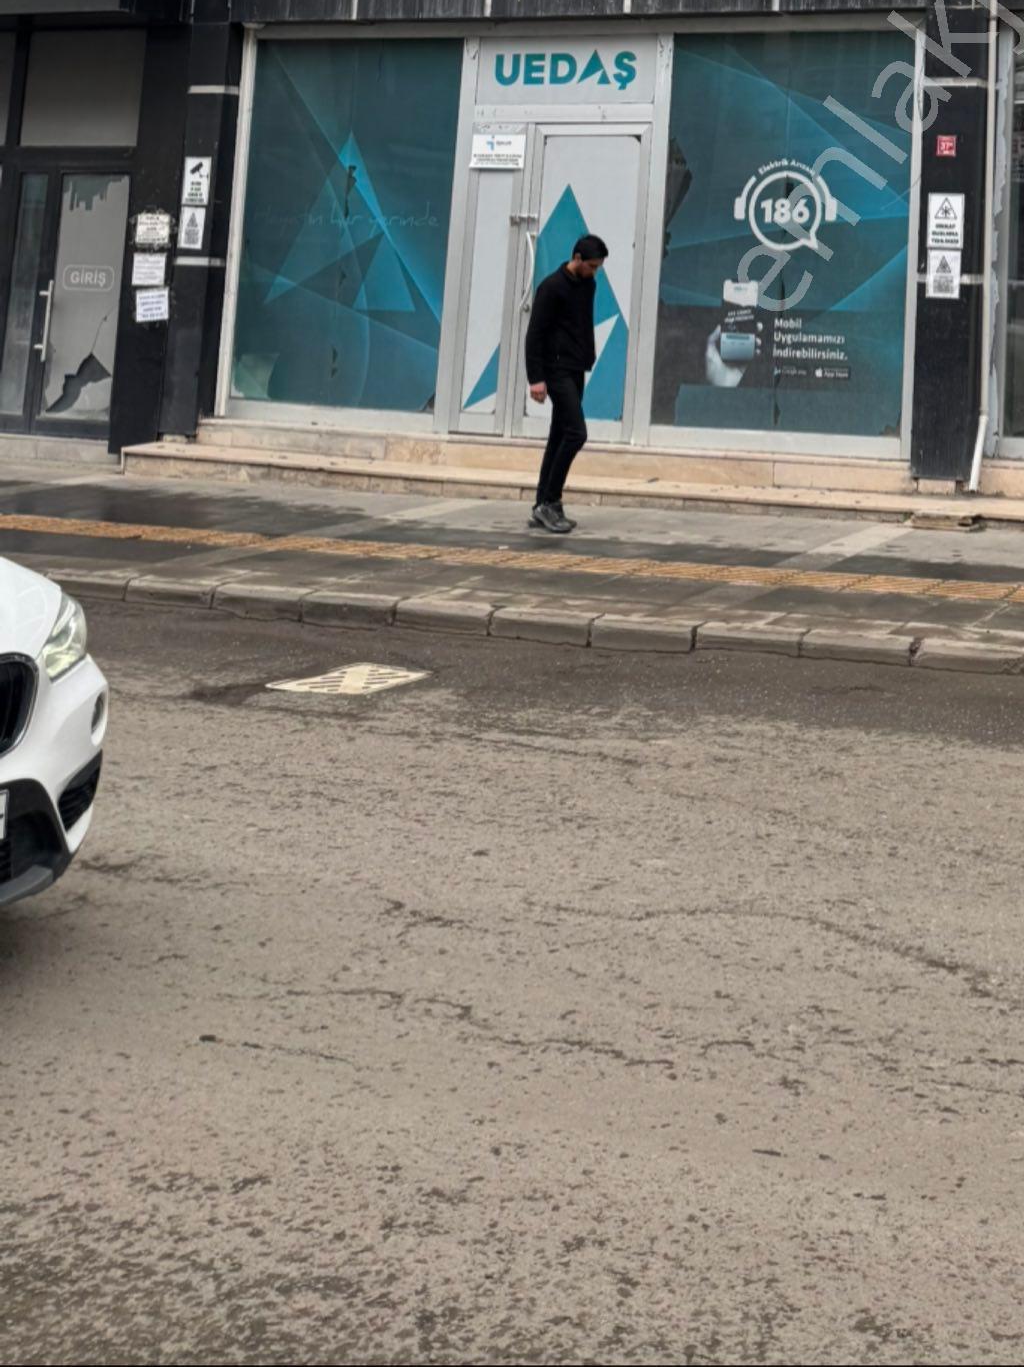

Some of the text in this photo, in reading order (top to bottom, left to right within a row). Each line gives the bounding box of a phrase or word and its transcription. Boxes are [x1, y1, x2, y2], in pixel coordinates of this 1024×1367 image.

[494, 49, 637, 91] UEDAŞ
[760, 197, 810, 224] 186
[70, 267, 106, 288] GİRİŞ
[773, 317, 802, 329] Mobil
[773, 331, 845, 345] Uygulamamızı
